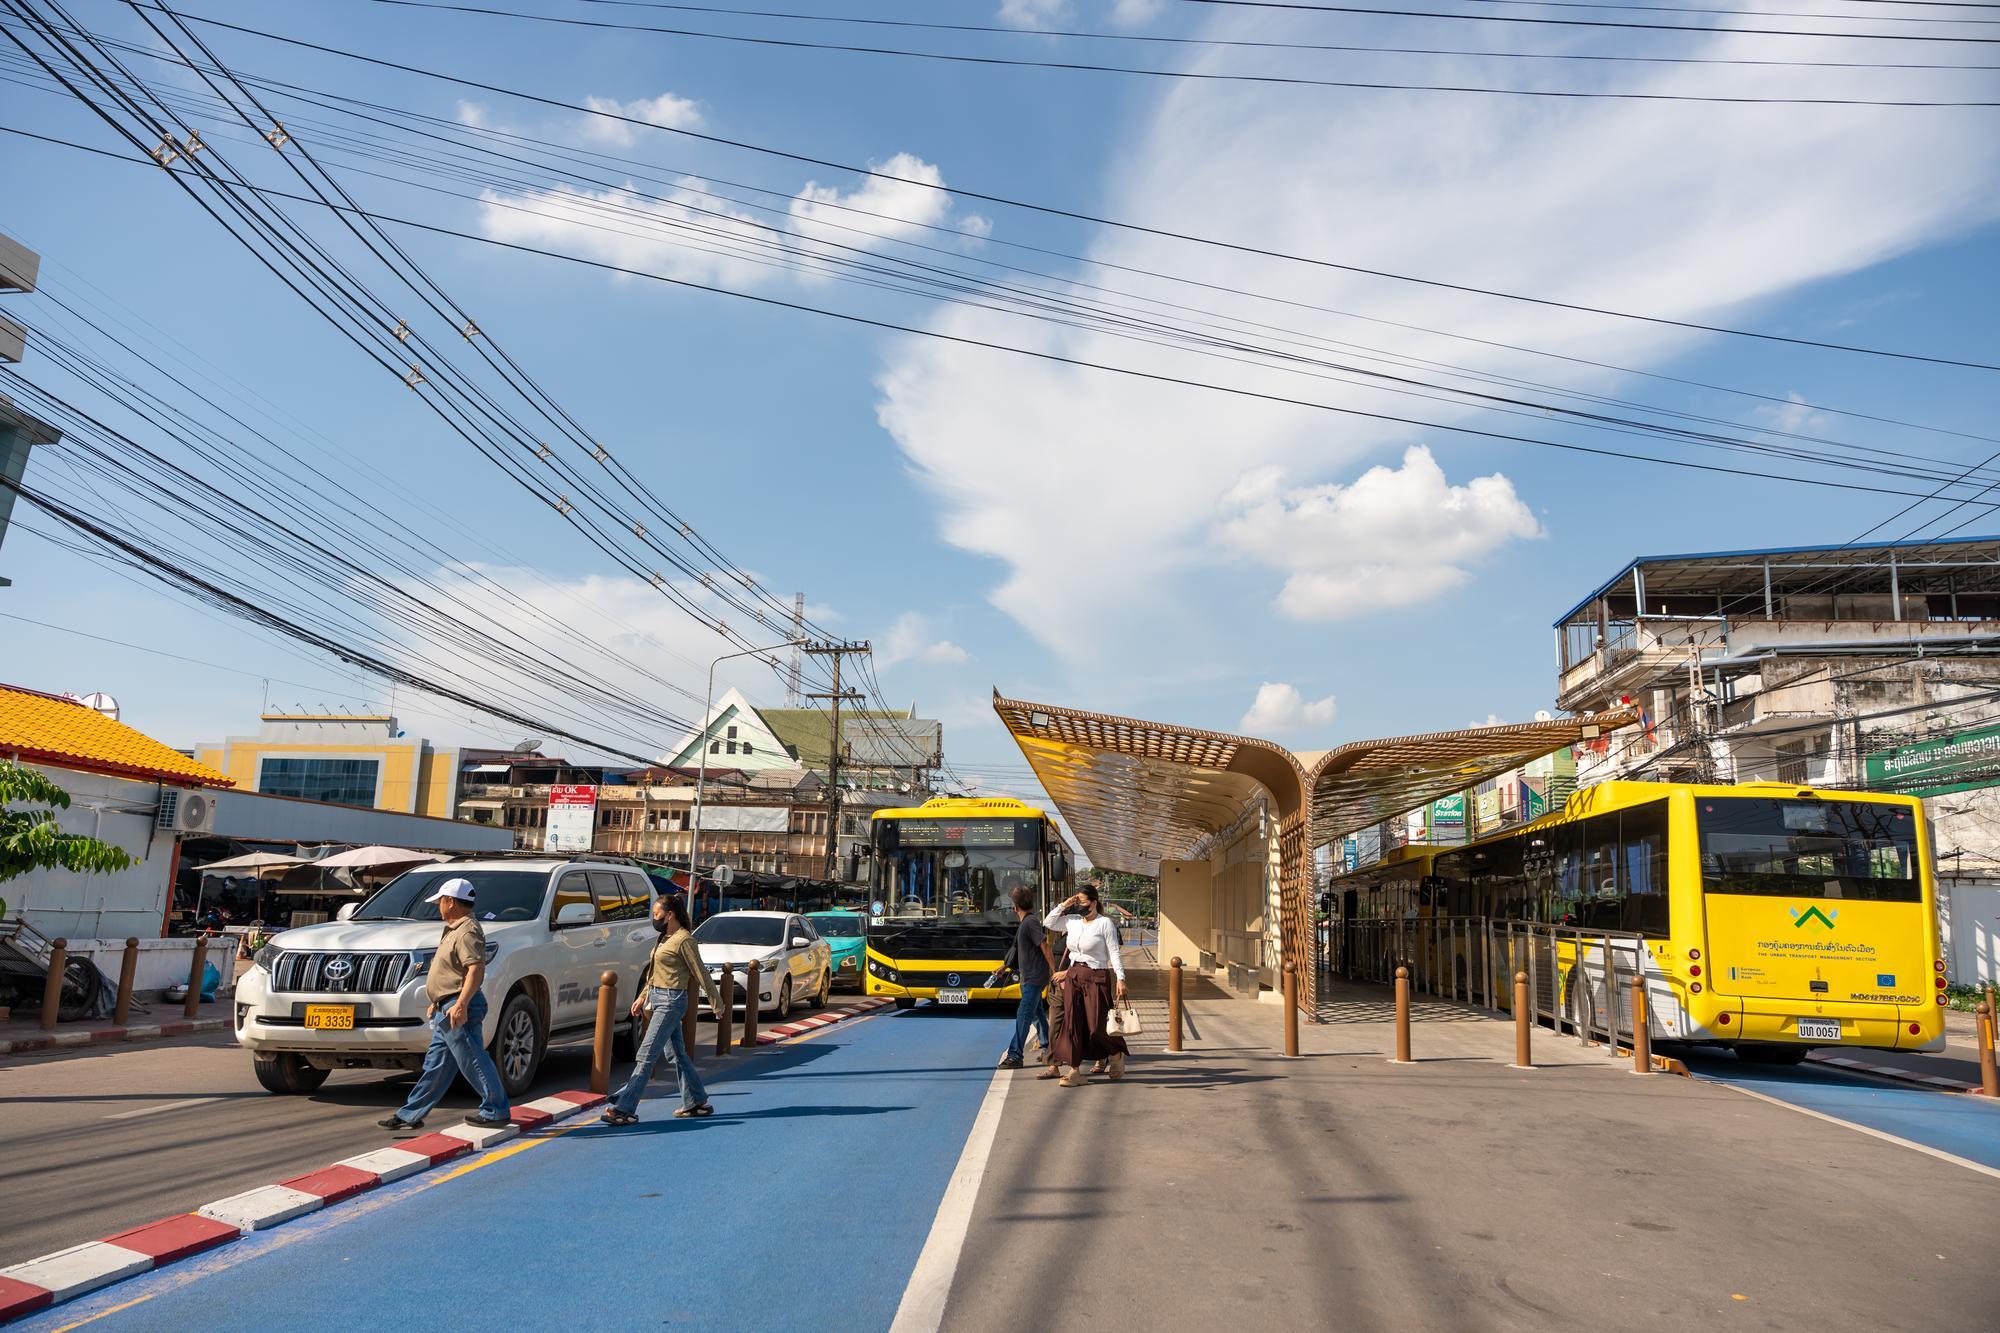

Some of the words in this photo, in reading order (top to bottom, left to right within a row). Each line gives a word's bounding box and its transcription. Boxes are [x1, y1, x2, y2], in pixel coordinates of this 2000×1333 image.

[564, 786, 578, 794] OK
[325, 1015, 351, 1027] 3335
[1816, 1026, 1839, 1038] 0057
